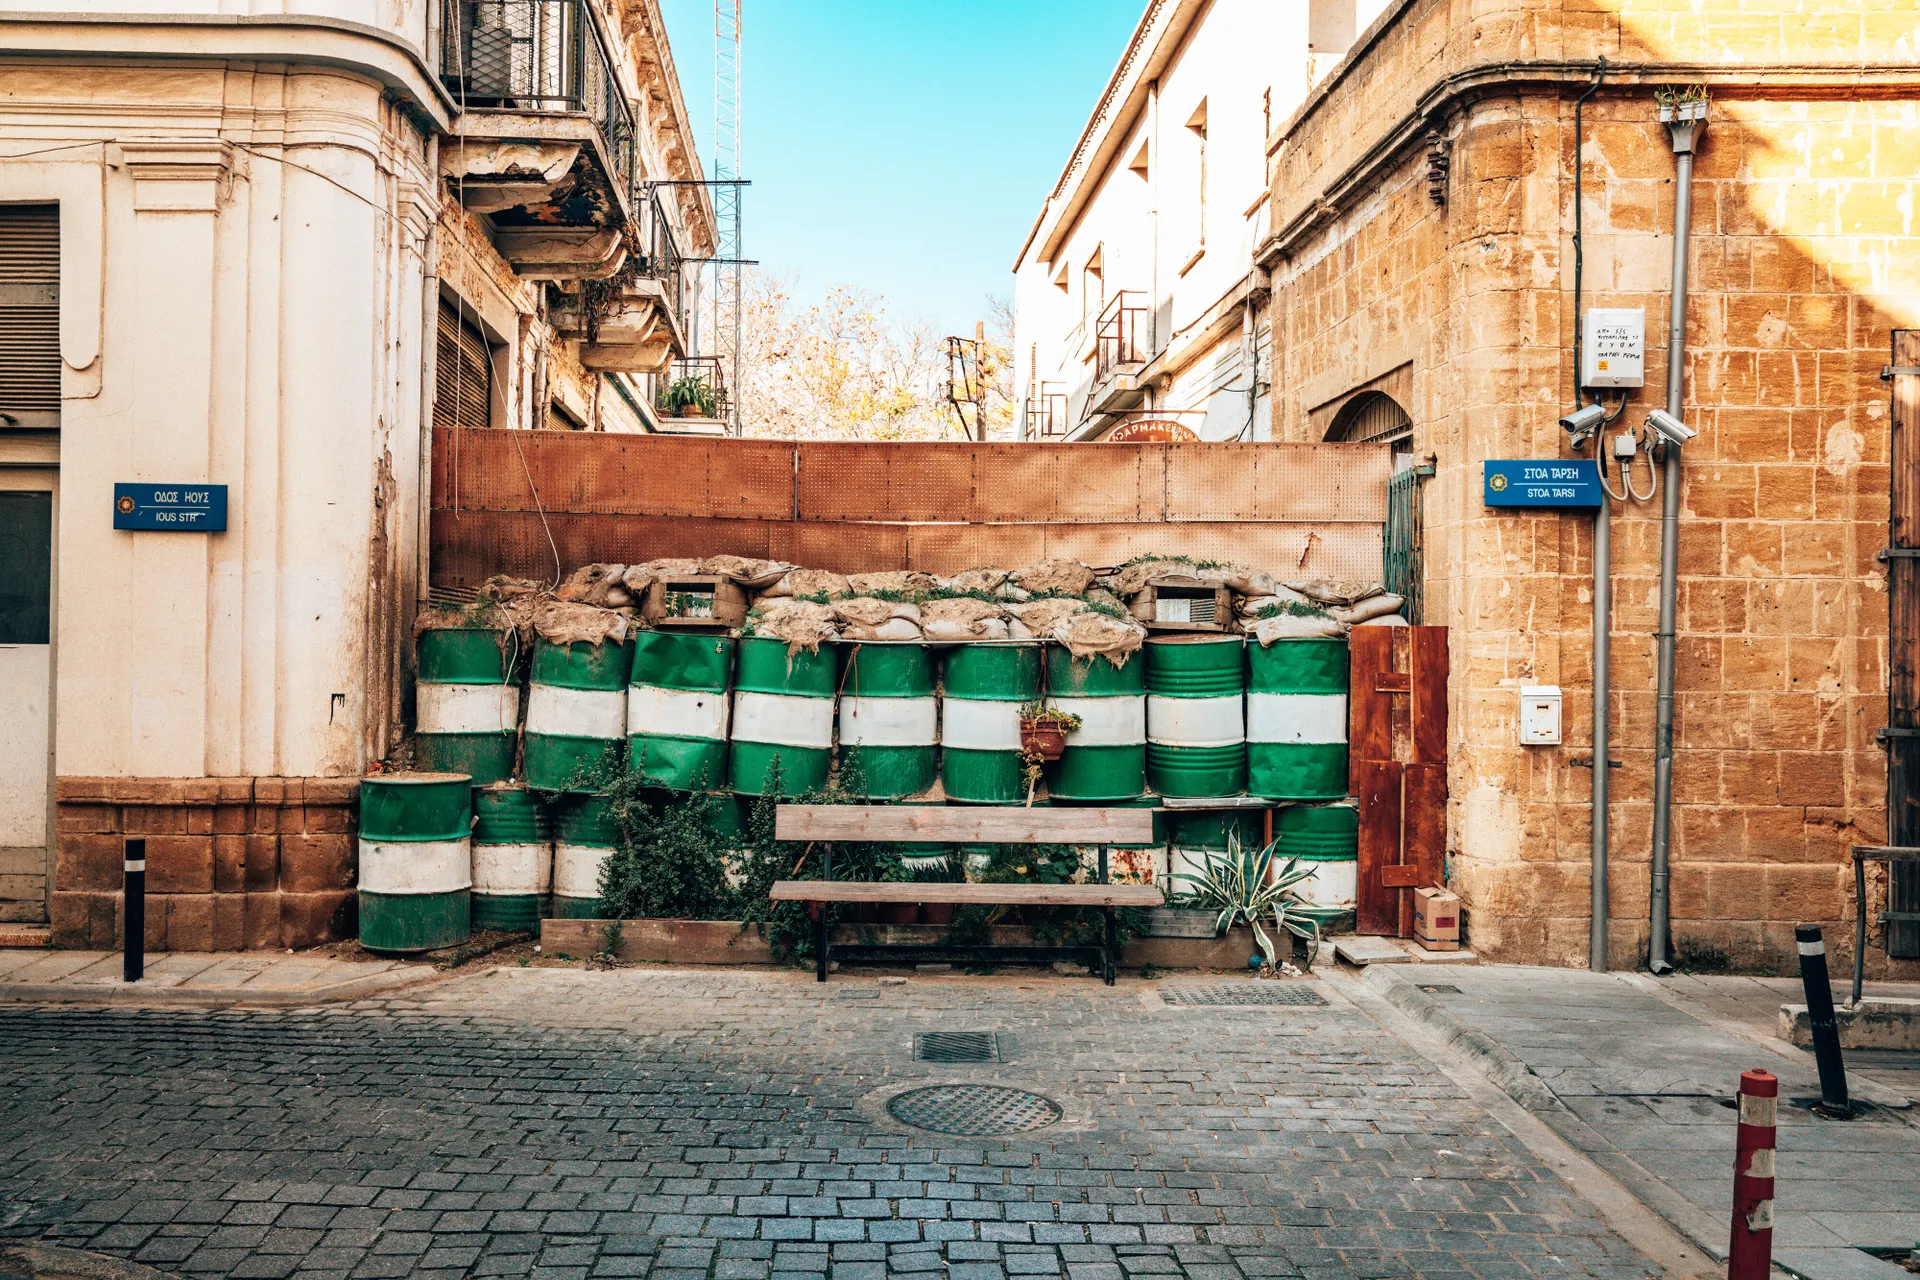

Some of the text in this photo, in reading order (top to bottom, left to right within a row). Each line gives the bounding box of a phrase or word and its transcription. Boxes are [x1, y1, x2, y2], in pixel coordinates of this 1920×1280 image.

[1524, 468, 1579, 479] ΣΤΟΑ ΤΑΡΣΗ
[154, 491, 209, 503] ΟΔΟΣ ΗΟΥΣ
[1527, 488, 1576, 498] STOA TARSI
[155, 512, 177, 522] IOUS
